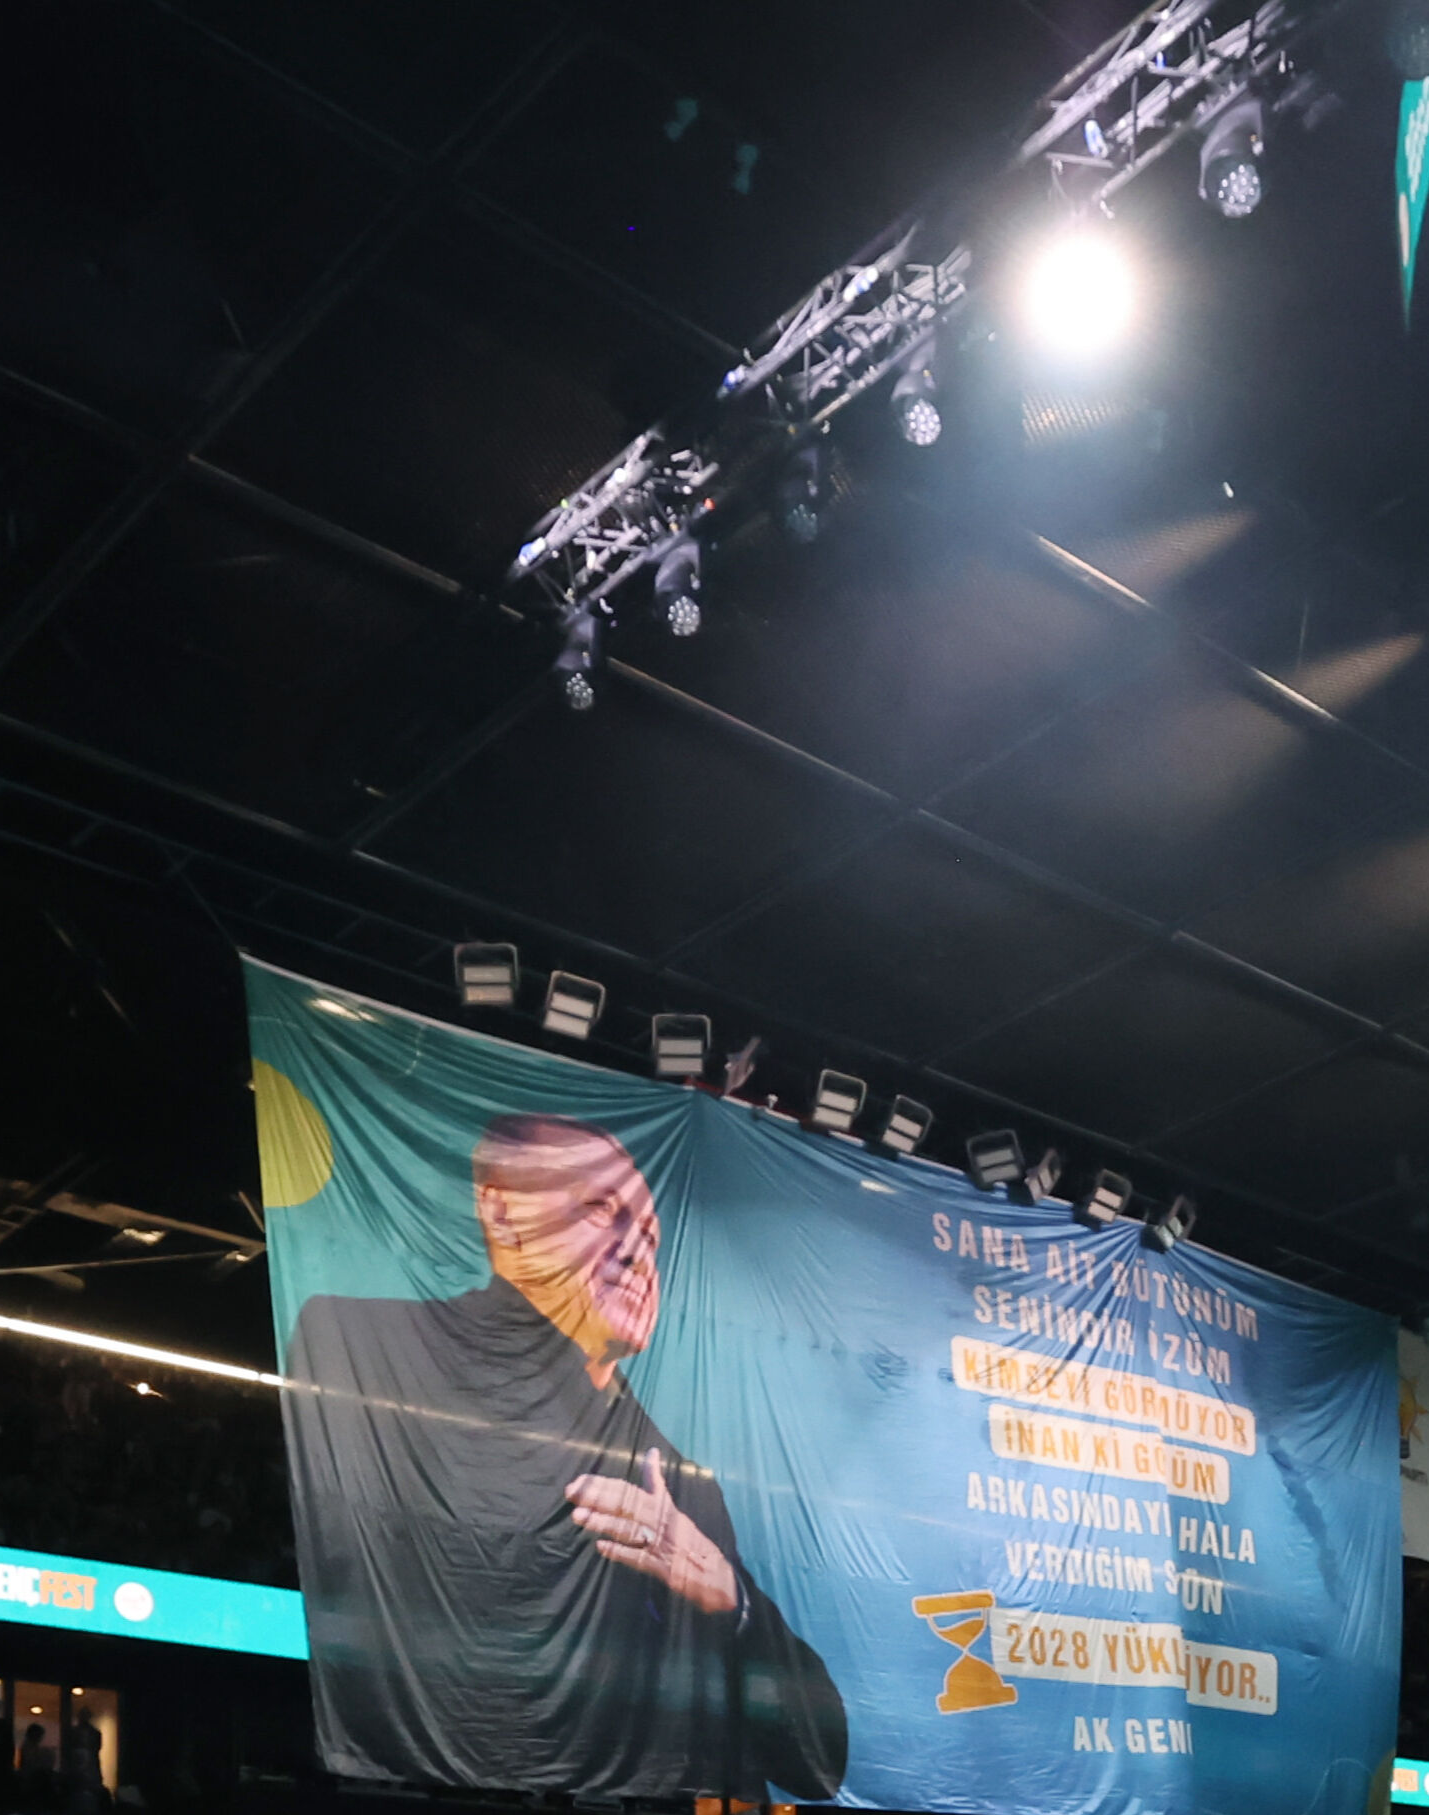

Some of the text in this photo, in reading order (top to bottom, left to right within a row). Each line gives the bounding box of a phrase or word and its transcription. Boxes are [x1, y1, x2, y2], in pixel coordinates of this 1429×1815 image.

[932, 1212, 1030, 1273] SANA
[1046, 1240, 1096, 1290] AİT
[1005, 1412, 1080, 1467] İNAN
[1093, 1431, 1121, 1469] Kİ
[1179, 1517, 1256, 1564] HALA
[1005, 1540, 1153, 1592] VERDİĞİM
[1007, 1623, 1089, 1671] 2028
[1074, 1716, 1114, 1754] AK
